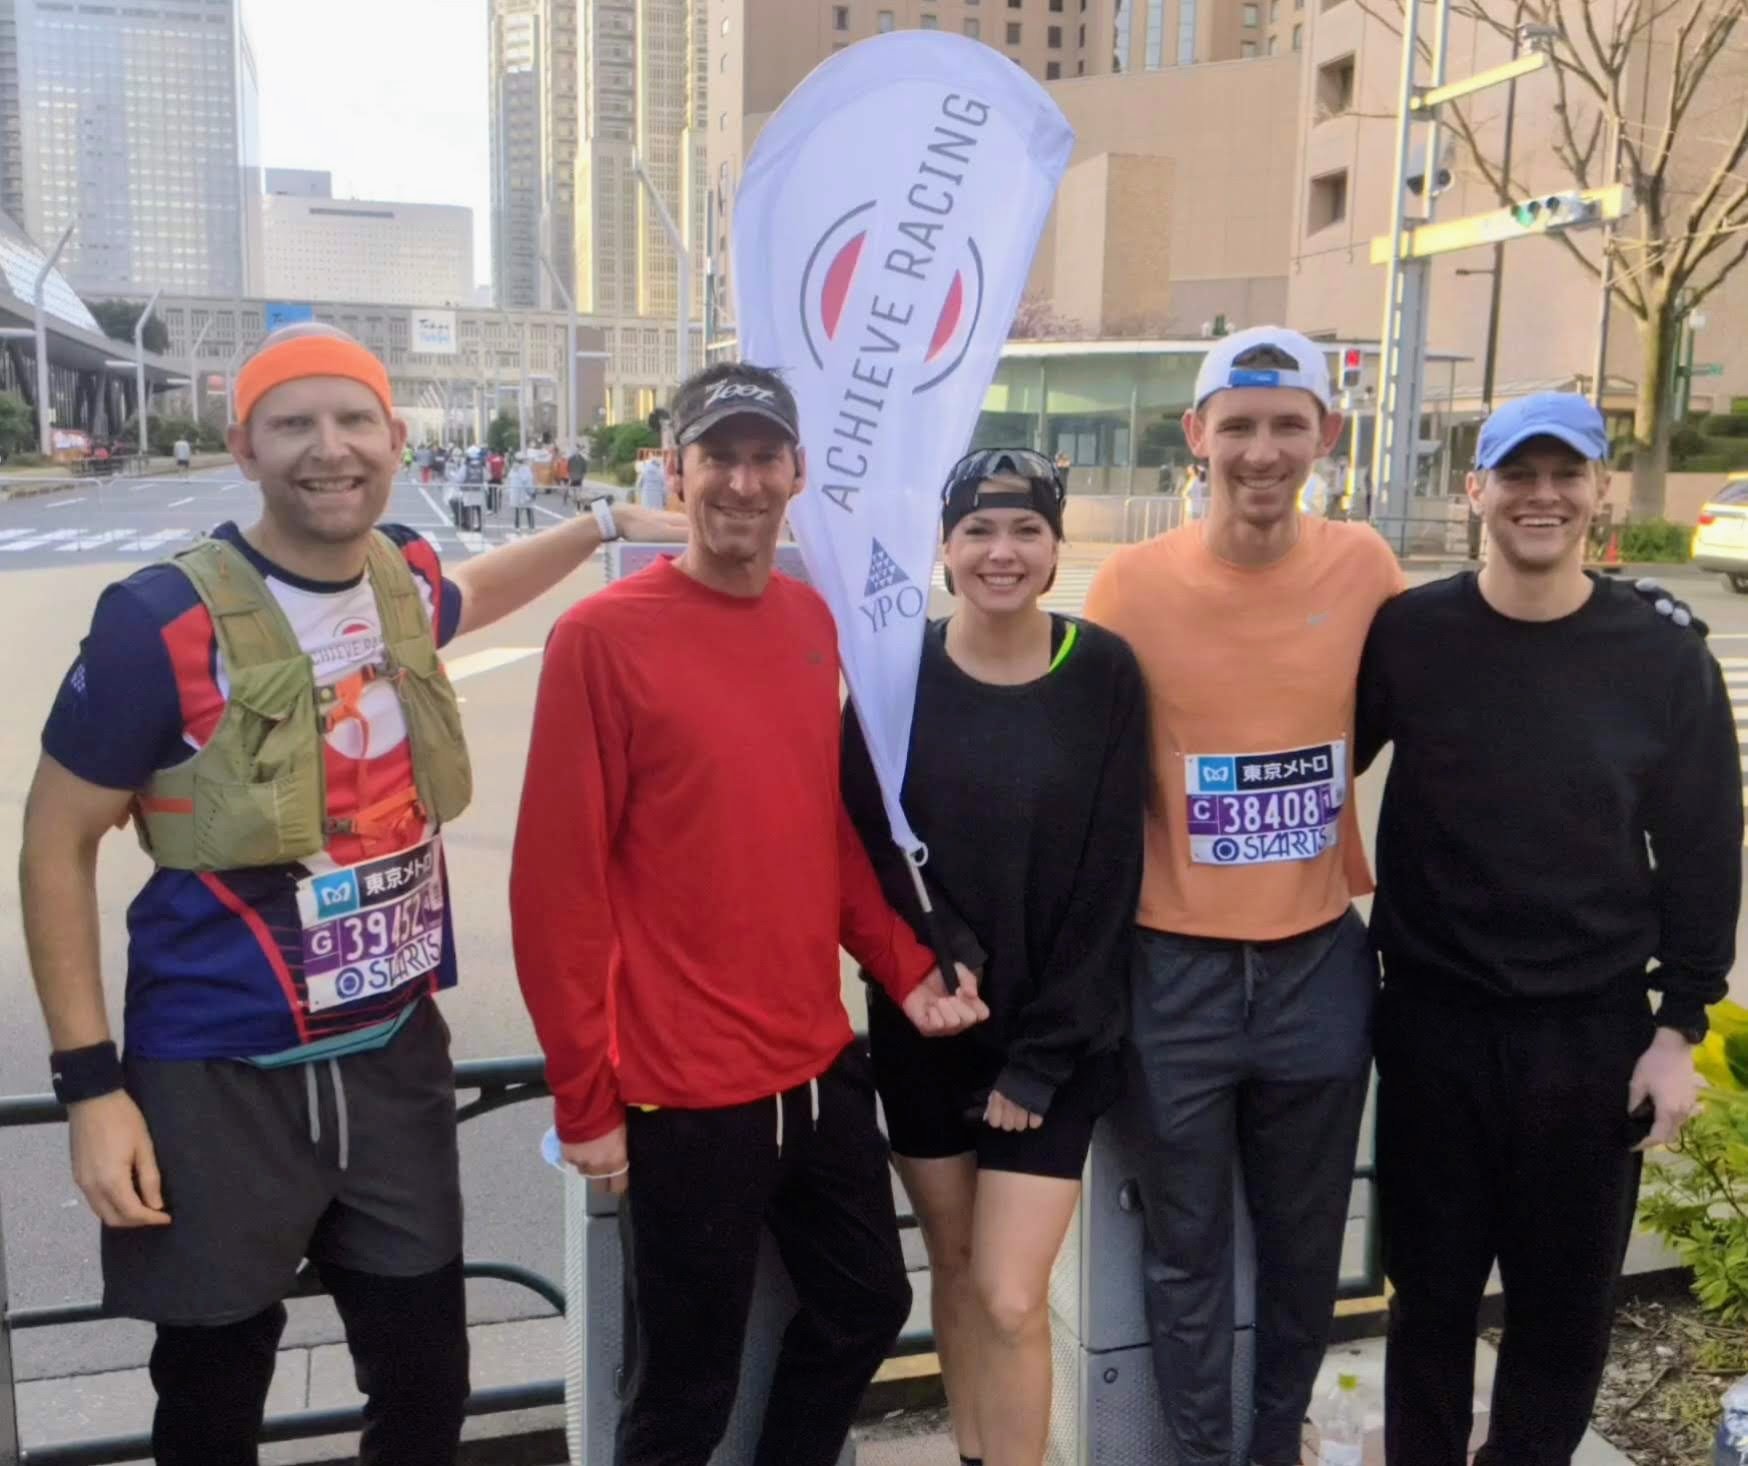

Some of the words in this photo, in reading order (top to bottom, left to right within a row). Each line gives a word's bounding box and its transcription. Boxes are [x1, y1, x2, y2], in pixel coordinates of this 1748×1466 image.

[821, 295, 914, 514] ACHIEVE
[884, 94, 990, 280] RACING
[859, 585, 924, 633] YPO
[1242, 755, 1328, 783] 東京メトロ
[1193, 800, 1211, 820] C
[1223, 789, 1319, 833] 38408
[364, 854, 433, 896] 東京メトロ
[311, 930, 333, 955] G
[368, 932, 441, 989] STARTS
